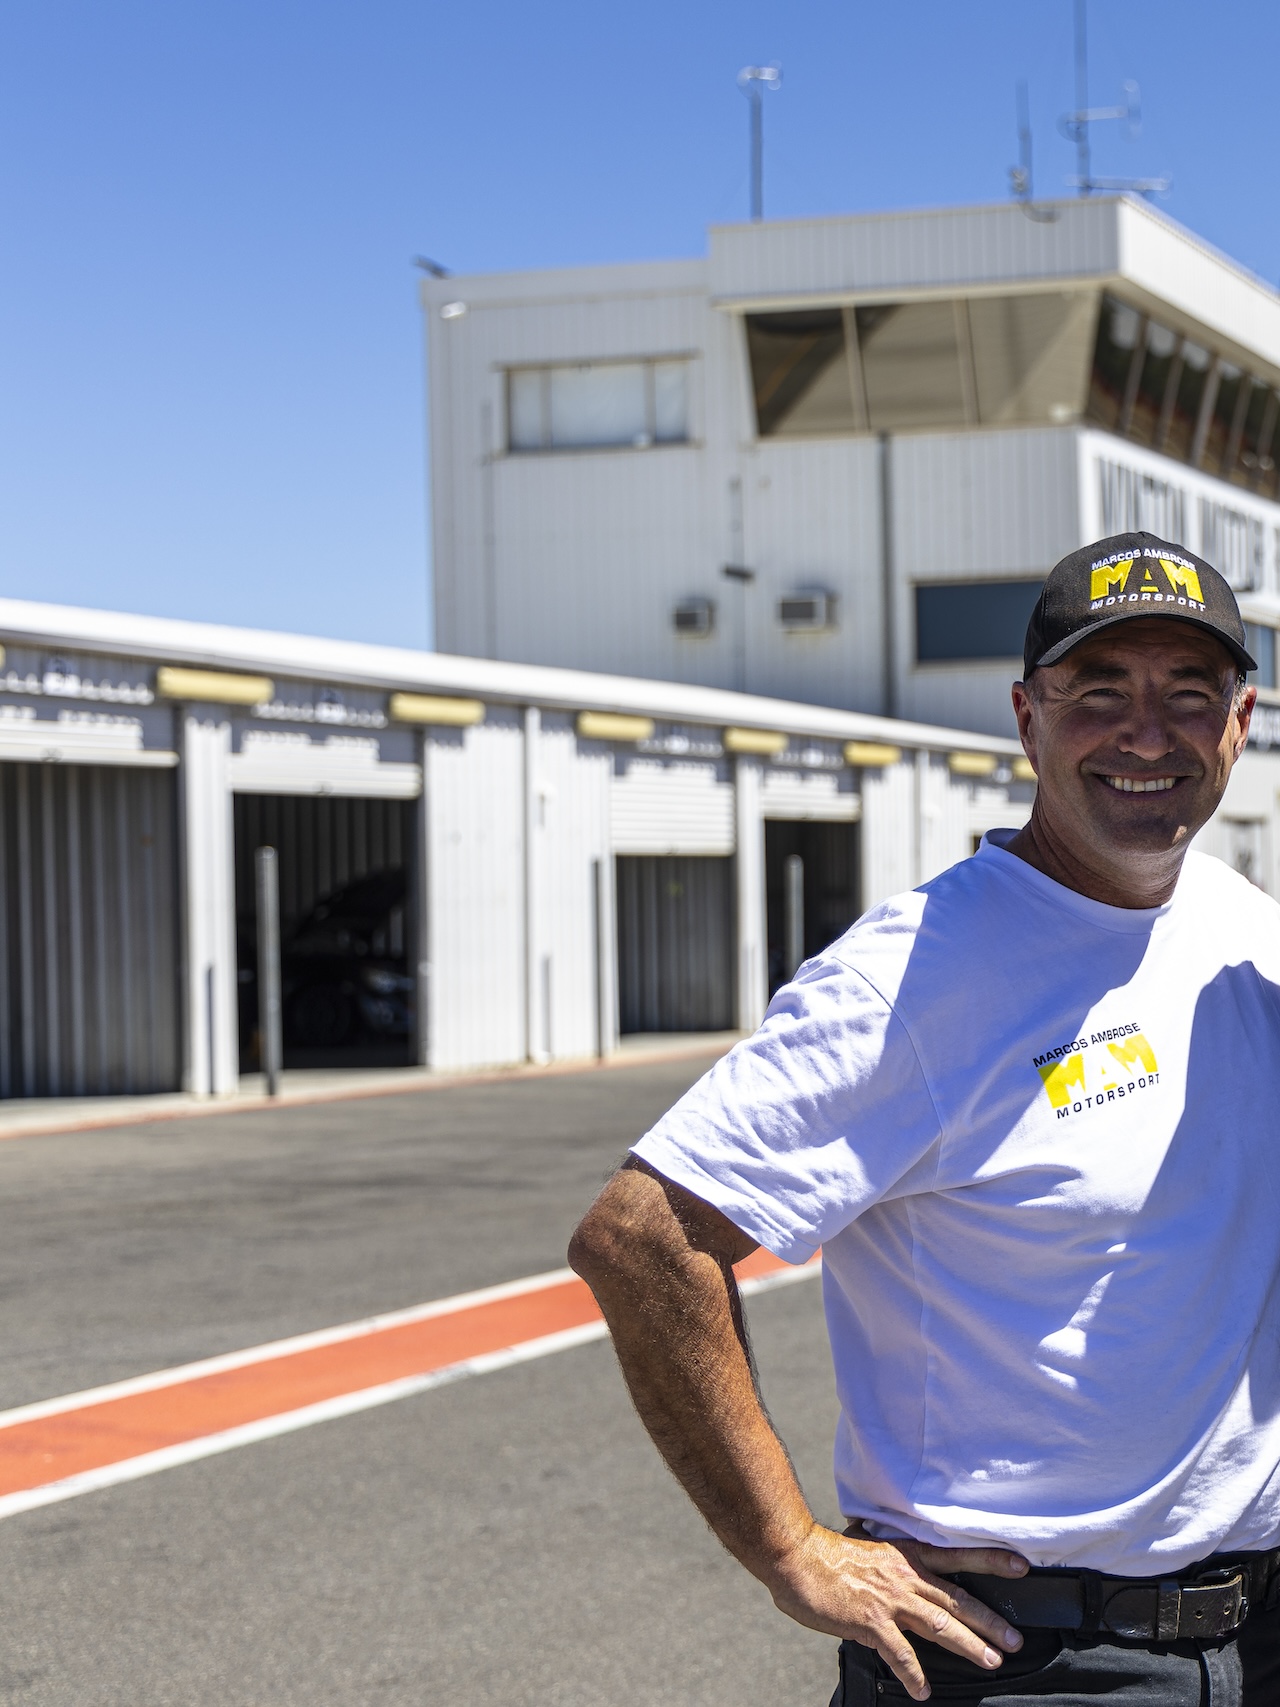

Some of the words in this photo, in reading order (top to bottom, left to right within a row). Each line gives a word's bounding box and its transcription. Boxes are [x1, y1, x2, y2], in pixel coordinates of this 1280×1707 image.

[1090, 559, 1204, 603] MAM
[1091, 548, 1141, 570] MARCOS
[1143, 548, 1197, 572] AMBROSE
[1090, 592, 1206, 612] MOTORSPORT
[1032, 1038, 1089, 1068] MARCOS
[1090, 1022, 1141, 1045] AMBROSE
[1037, 1033, 1159, 1109] MAM
[1056, 1073, 1160, 1120] MOTORSPORT
